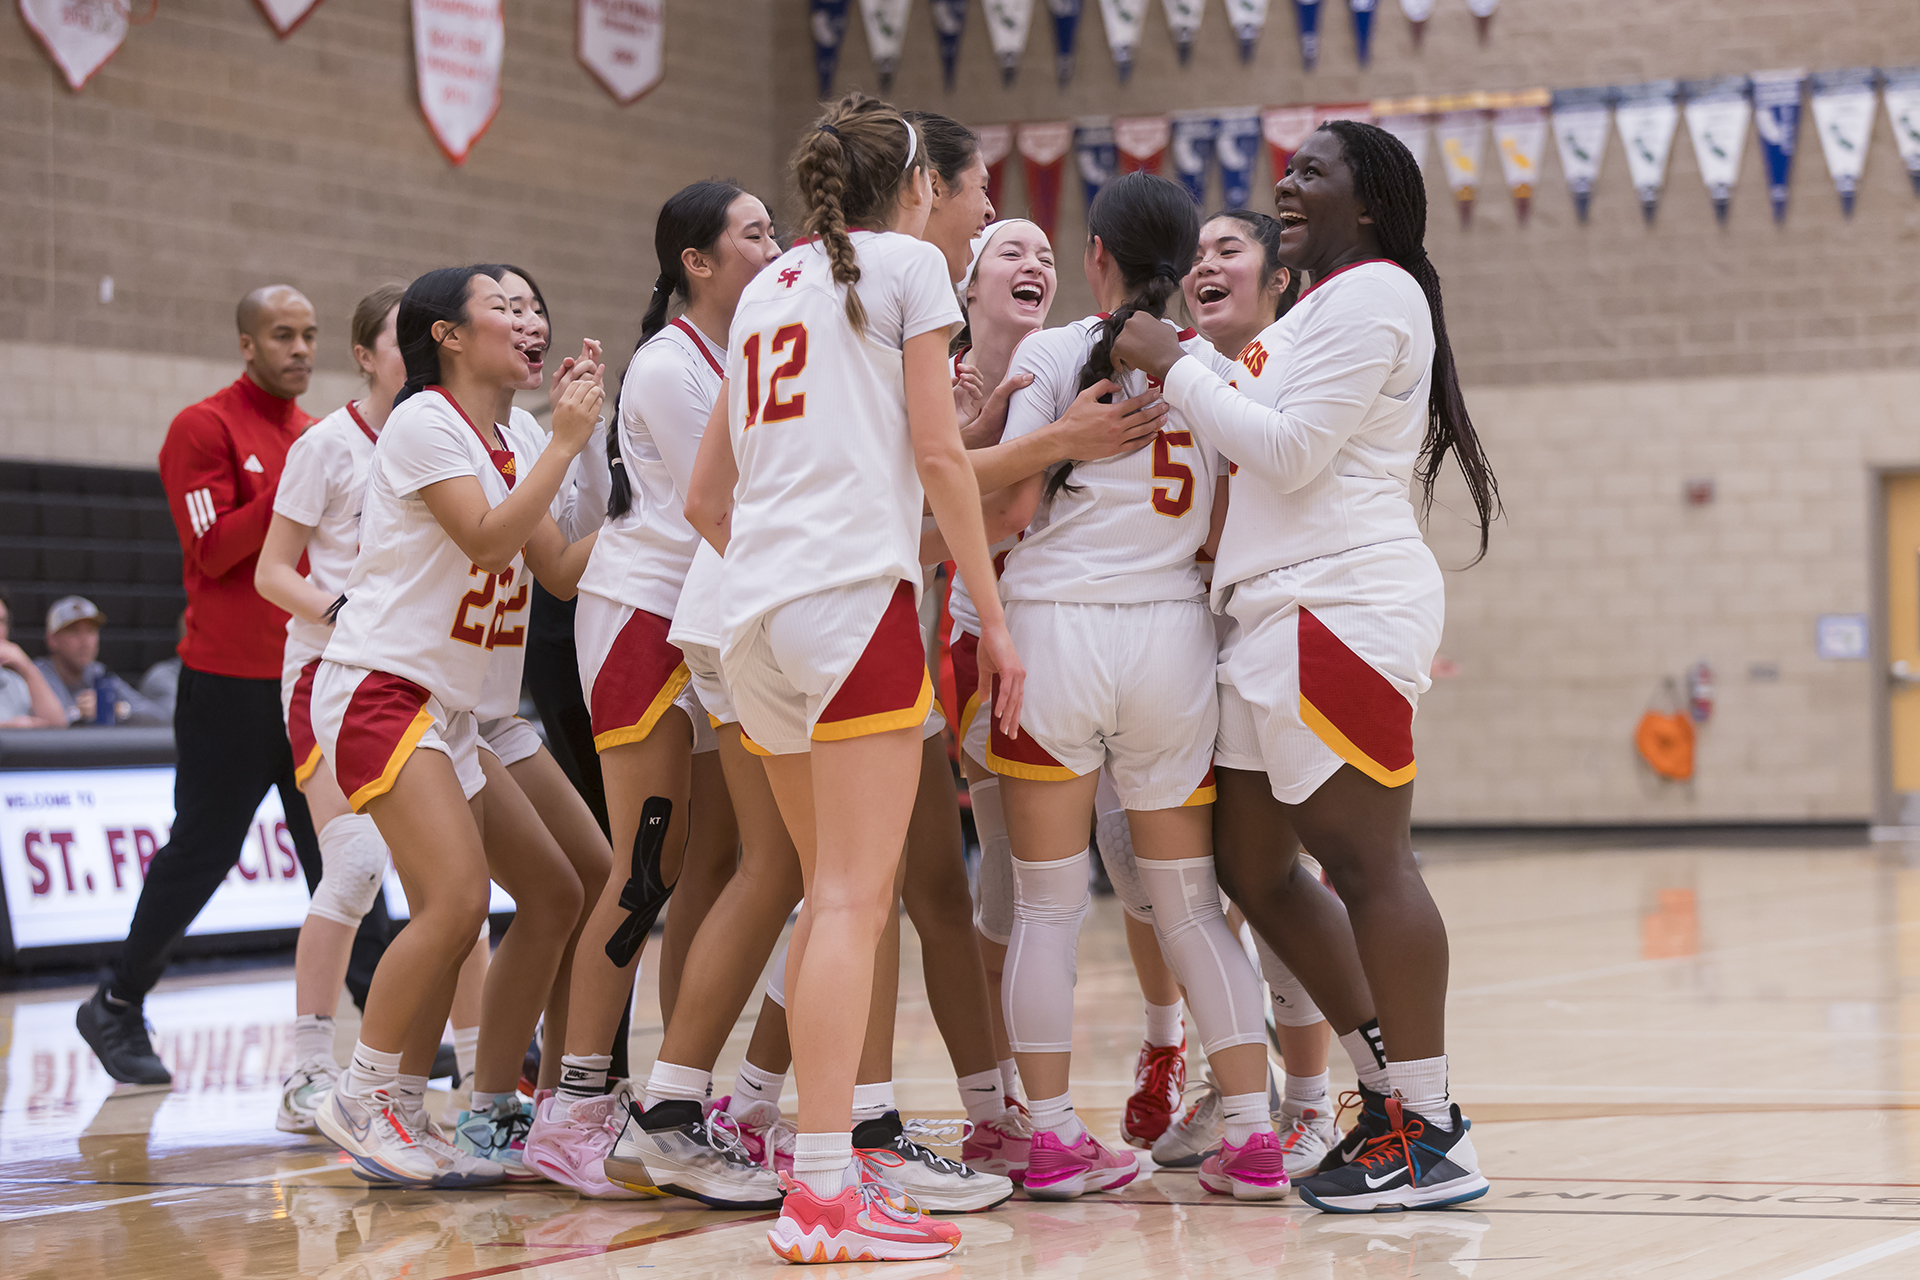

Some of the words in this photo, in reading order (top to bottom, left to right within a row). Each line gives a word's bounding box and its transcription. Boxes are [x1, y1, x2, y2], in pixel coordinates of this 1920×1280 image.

[777, 268, 802, 288] SF
[743, 321, 809, 433] 12
[1150, 428, 1195, 519] 5
[5, 791, 71, 807] WELCOME
[649, 816, 662, 825] KT
[24, 830, 95, 895] ST.
